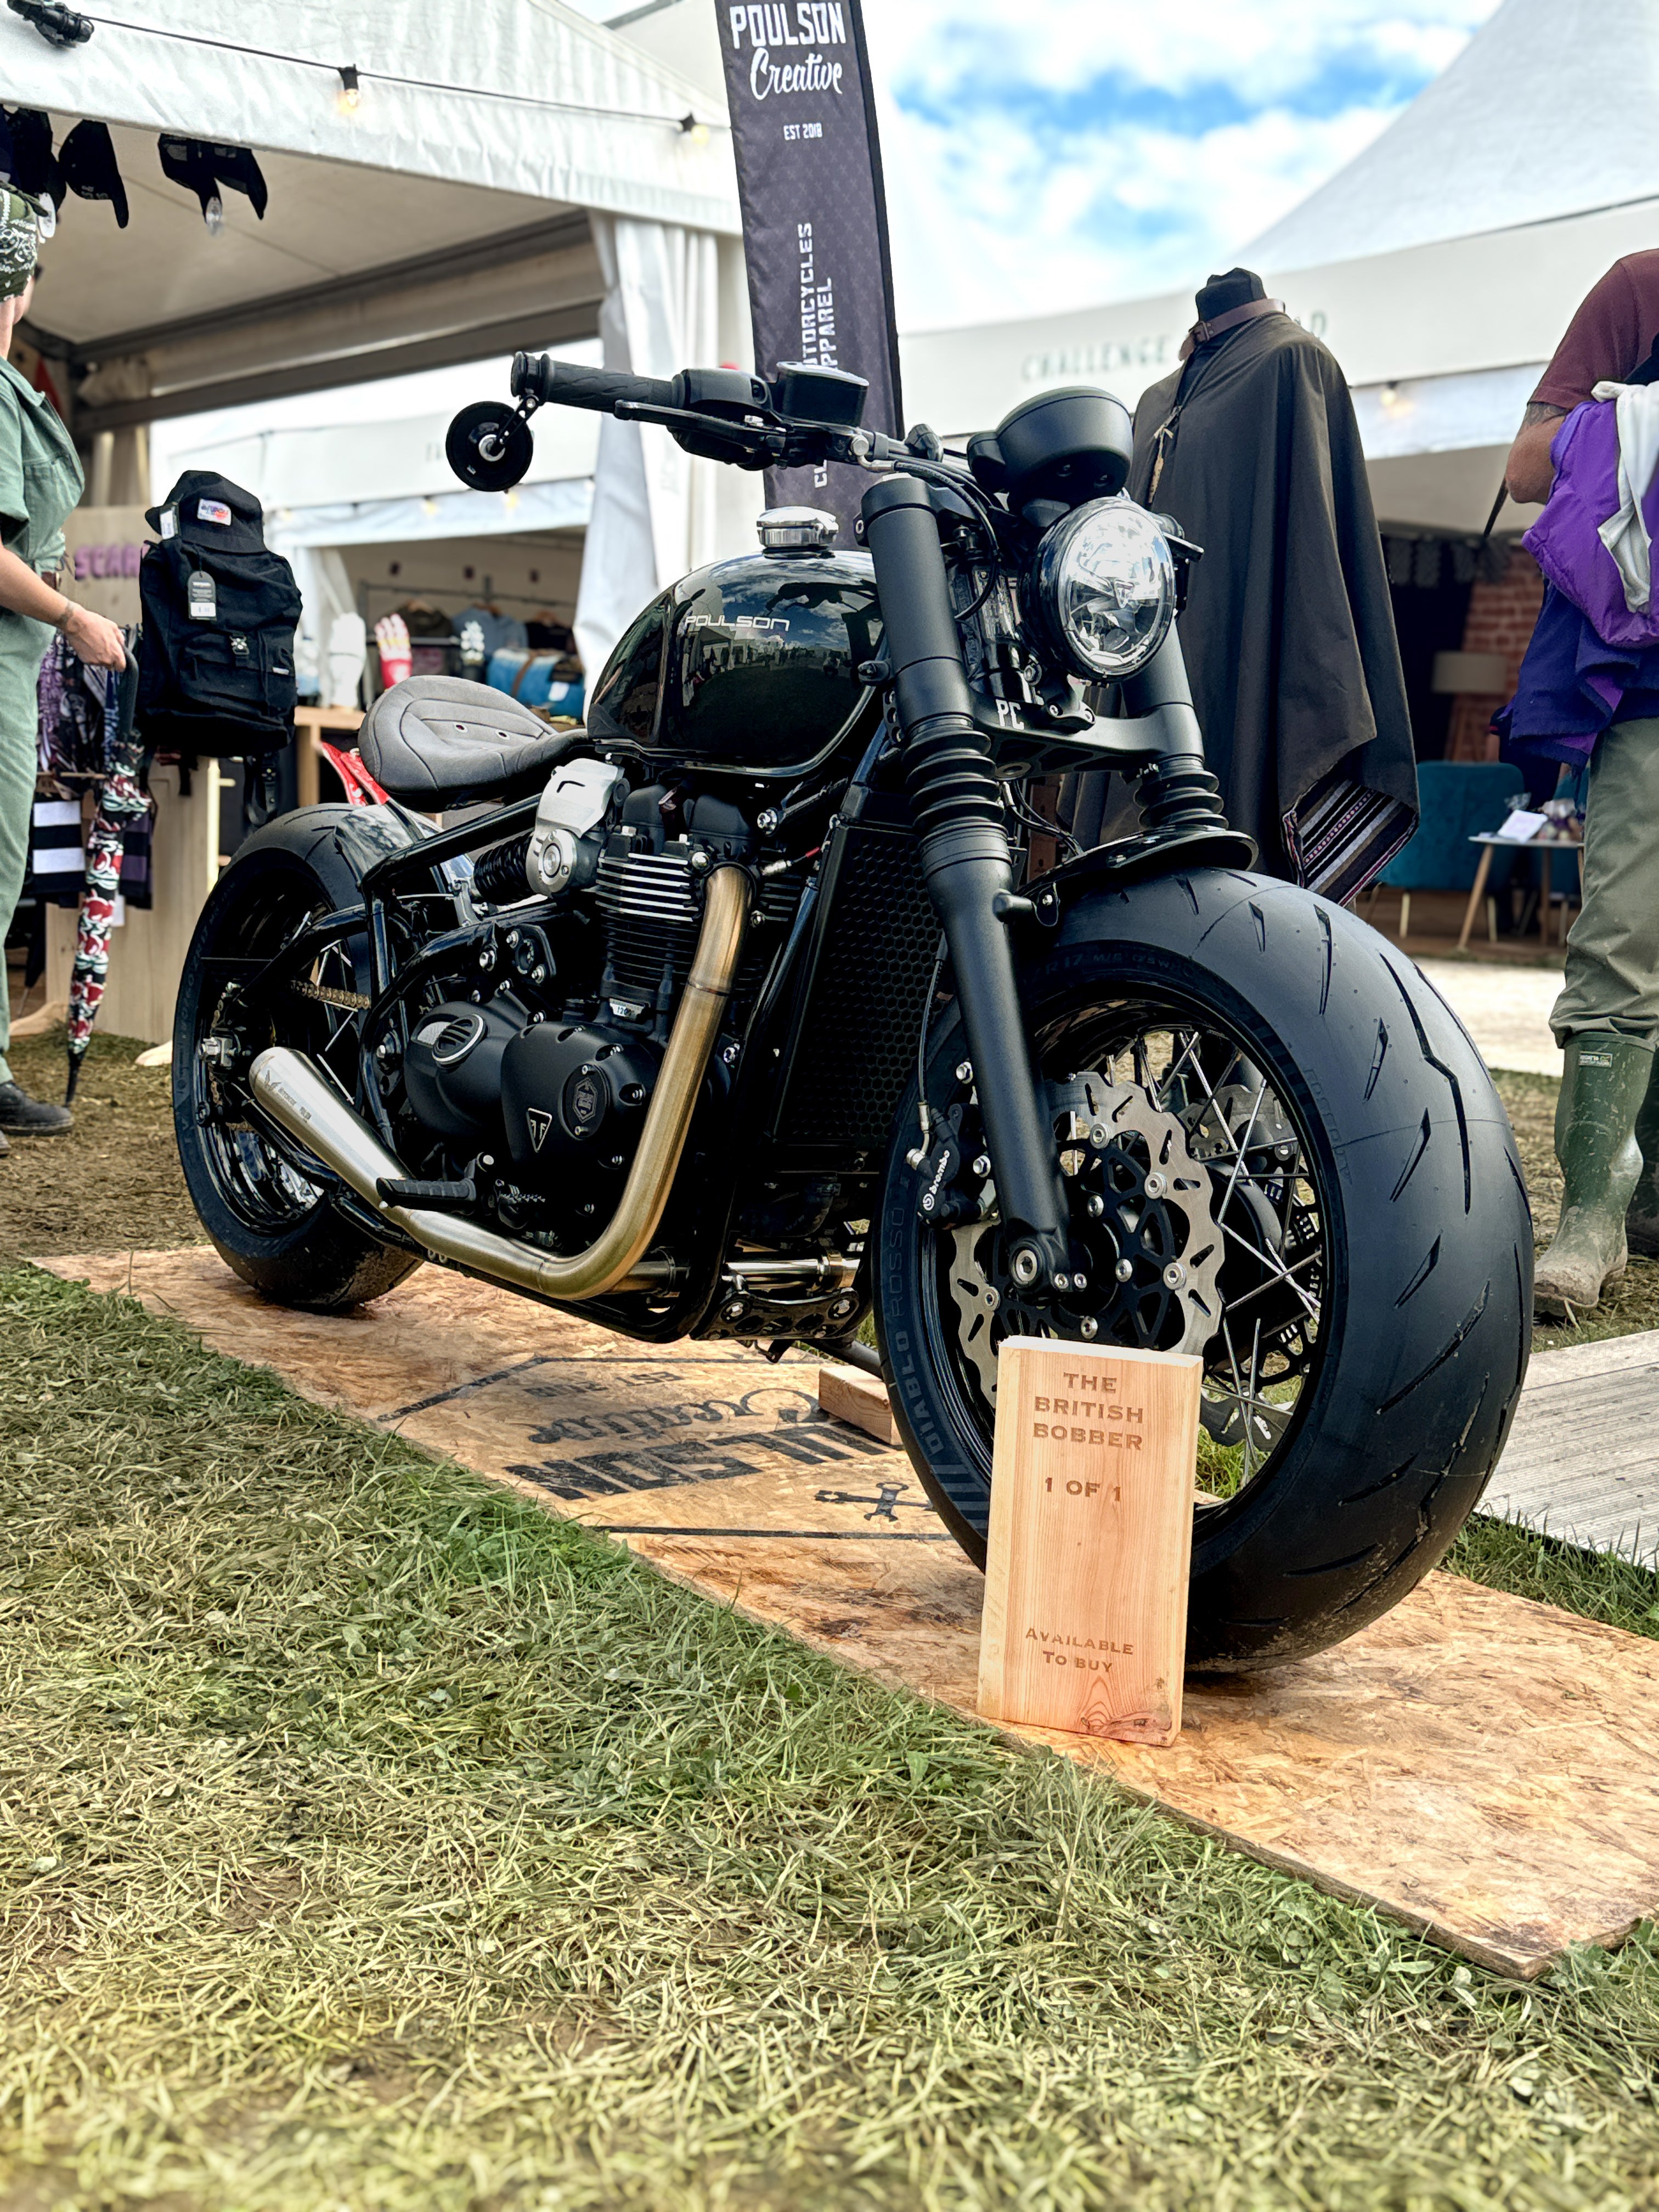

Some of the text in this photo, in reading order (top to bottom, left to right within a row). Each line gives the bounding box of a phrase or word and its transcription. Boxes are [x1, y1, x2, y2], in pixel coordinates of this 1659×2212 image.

[730, 3, 846, 49] POULSON
[750, 47, 843, 100] Creative
[783, 124, 801, 141] EST
[798, 223, 818, 364] TORCYCLES
[817, 278, 838, 366] PPAREL
[686, 614, 790, 631] POULSON
[995, 698, 1024, 730] PC
[888, 1207, 944, 1455] DIABLO ROSSO
[1063, 1372, 1117, 1394] THE
[1035, 1396, 1144, 1424] BRITISH
[1033, 1422, 1143, 1451] BOBBER
[1045, 1477, 1121, 1502] 1 OF 1
[1025, 1627, 1133, 1656] AVAILABLE
[1042, 1650, 1113, 1673] TO BUY
